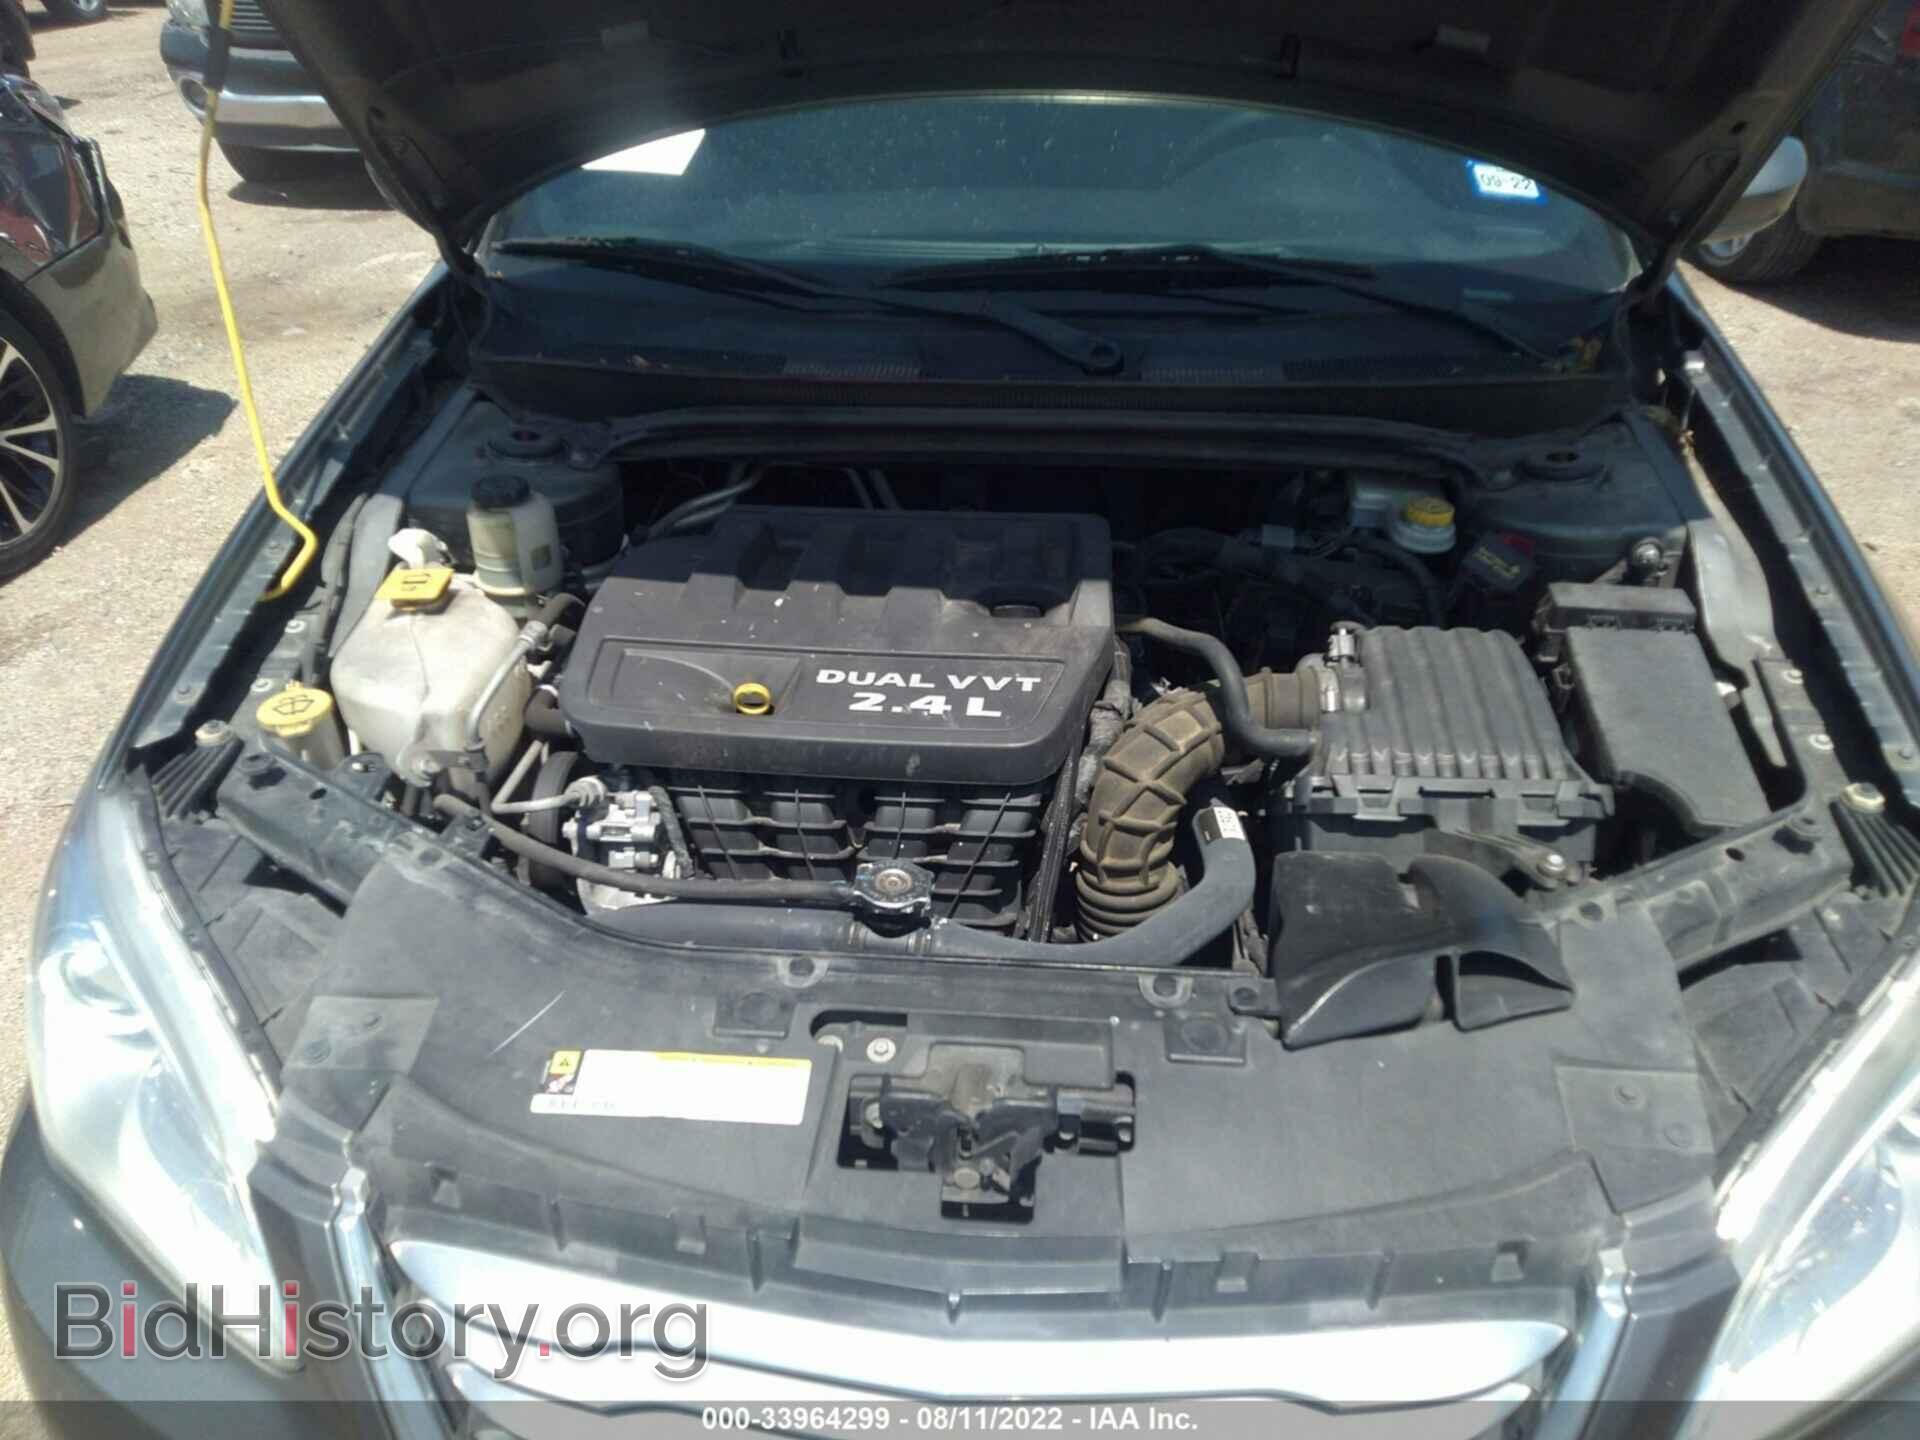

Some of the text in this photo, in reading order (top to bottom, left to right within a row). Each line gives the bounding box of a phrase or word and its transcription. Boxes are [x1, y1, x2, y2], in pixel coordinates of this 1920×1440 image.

[815, 669, 1041, 691] DUAL VVT
[849, 692, 1001, 717] 2.4 L
